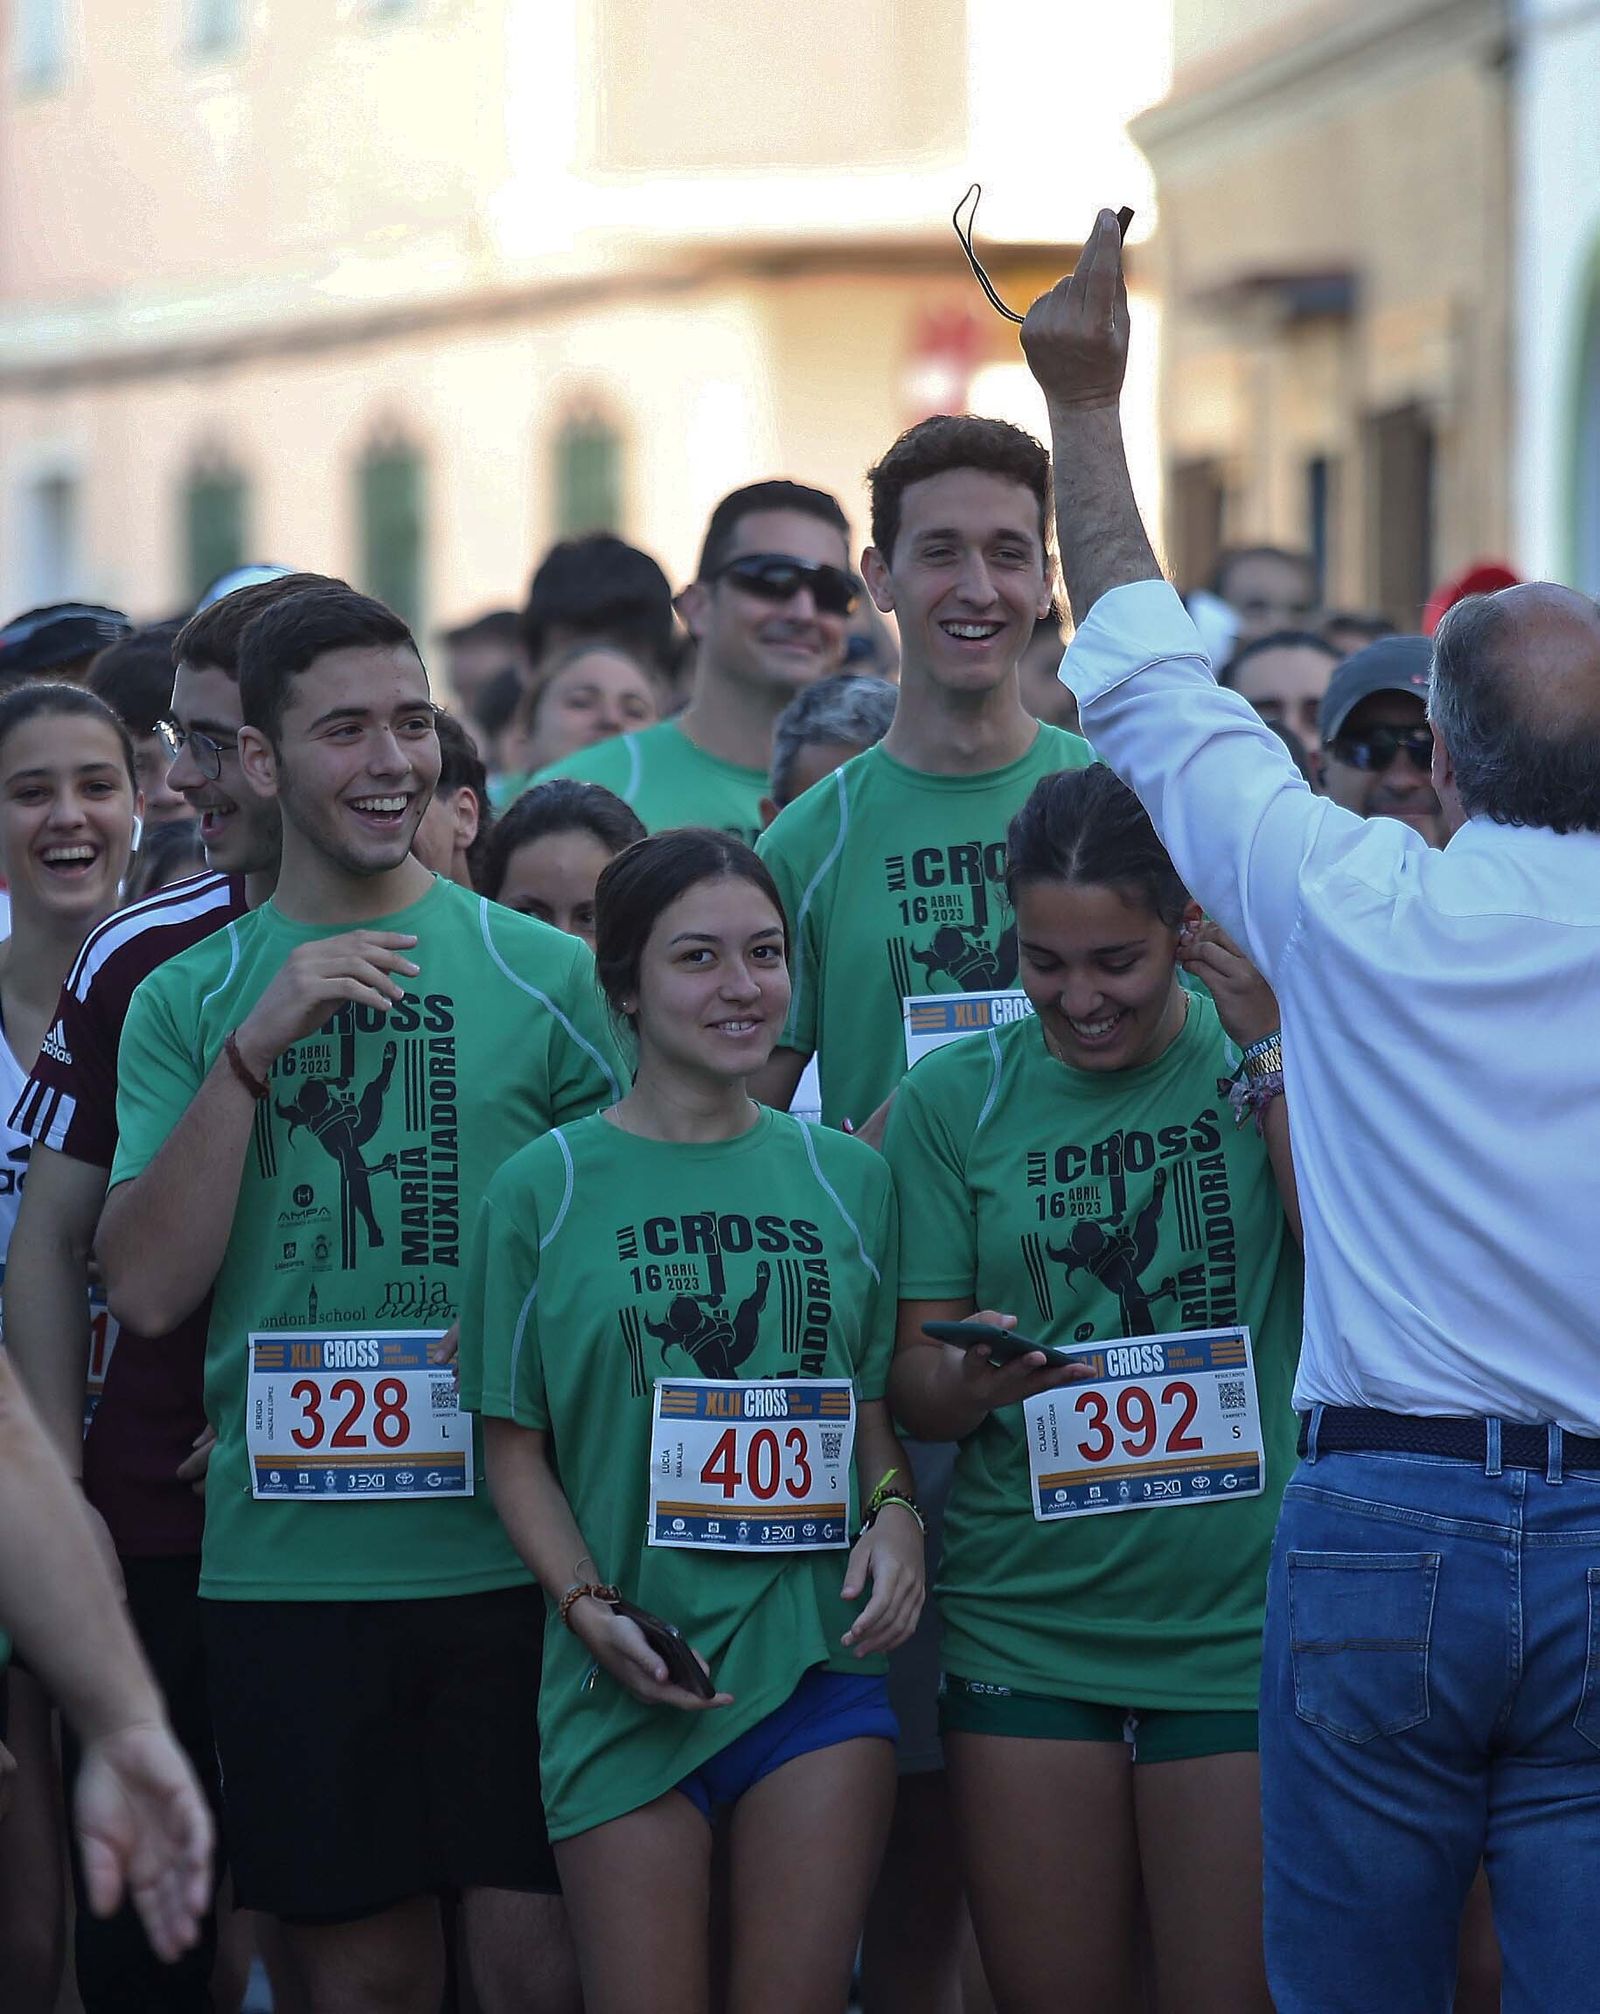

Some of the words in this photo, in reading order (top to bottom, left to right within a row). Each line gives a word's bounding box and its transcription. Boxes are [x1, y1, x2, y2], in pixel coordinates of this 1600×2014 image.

[884, 855, 907, 893] XLII
[912, 842, 1008, 888] CRO
[898, 896, 929, 926] 16
[931, 895, 964, 908] ABRIL
[933, 908, 964, 922] 2023
[320, 991, 455, 1035] ROSS
[954, 1002, 990, 1028] XLII
[990, 998, 1037, 1026] CROS
[271, 1048, 297, 1078] 16
[299, 1043, 332, 1060] ABRIL
[300, 1060, 331, 1074] 2023
[429, 1036, 460, 1268] AUXILIADORA
[1054, 1108, 1222, 1184] CROSS
[1027, 1151, 1047, 1188] XLII
[1036, 1191, 1066, 1221] 16
[1068, 1186, 1101, 1202] ABRIL
[277, 1206, 331, 1222] AMPA
[1069, 1202, 1101, 1217] 2023
[616, 1225, 638, 1262] XLII
[643, 1212, 824, 1256] CROSS
[1196, 1152, 1238, 1328] XILIADORA
[630, 1264, 663, 1295] 16
[664, 1263, 699, 1277] ABRIL
[668, 1277, 700, 1291] 2023
[384, 1274, 449, 1304] mia
[1178, 1263, 1208, 1330] RIA
[259, 1312, 306, 1329] ondon
[318, 1306, 367, 1324] school
[800, 1258, 832, 1378] ADORA
[323, 1340, 379, 1369] CROSS
[1106, 1344, 1165, 1378] CROSS
[255, 1399, 263, 1431] SERGIO
[289, 1377, 411, 1450] 328
[743, 1388, 789, 1418] CROSS
[441, 1425, 450, 1439] L
[1036, 1415, 1047, 1452] CLAUDIA
[1073, 1381, 1204, 1462] 392
[1232, 1425, 1241, 1439] S
[699, 1427, 813, 1500] 403
[830, 1475, 837, 1490] S
